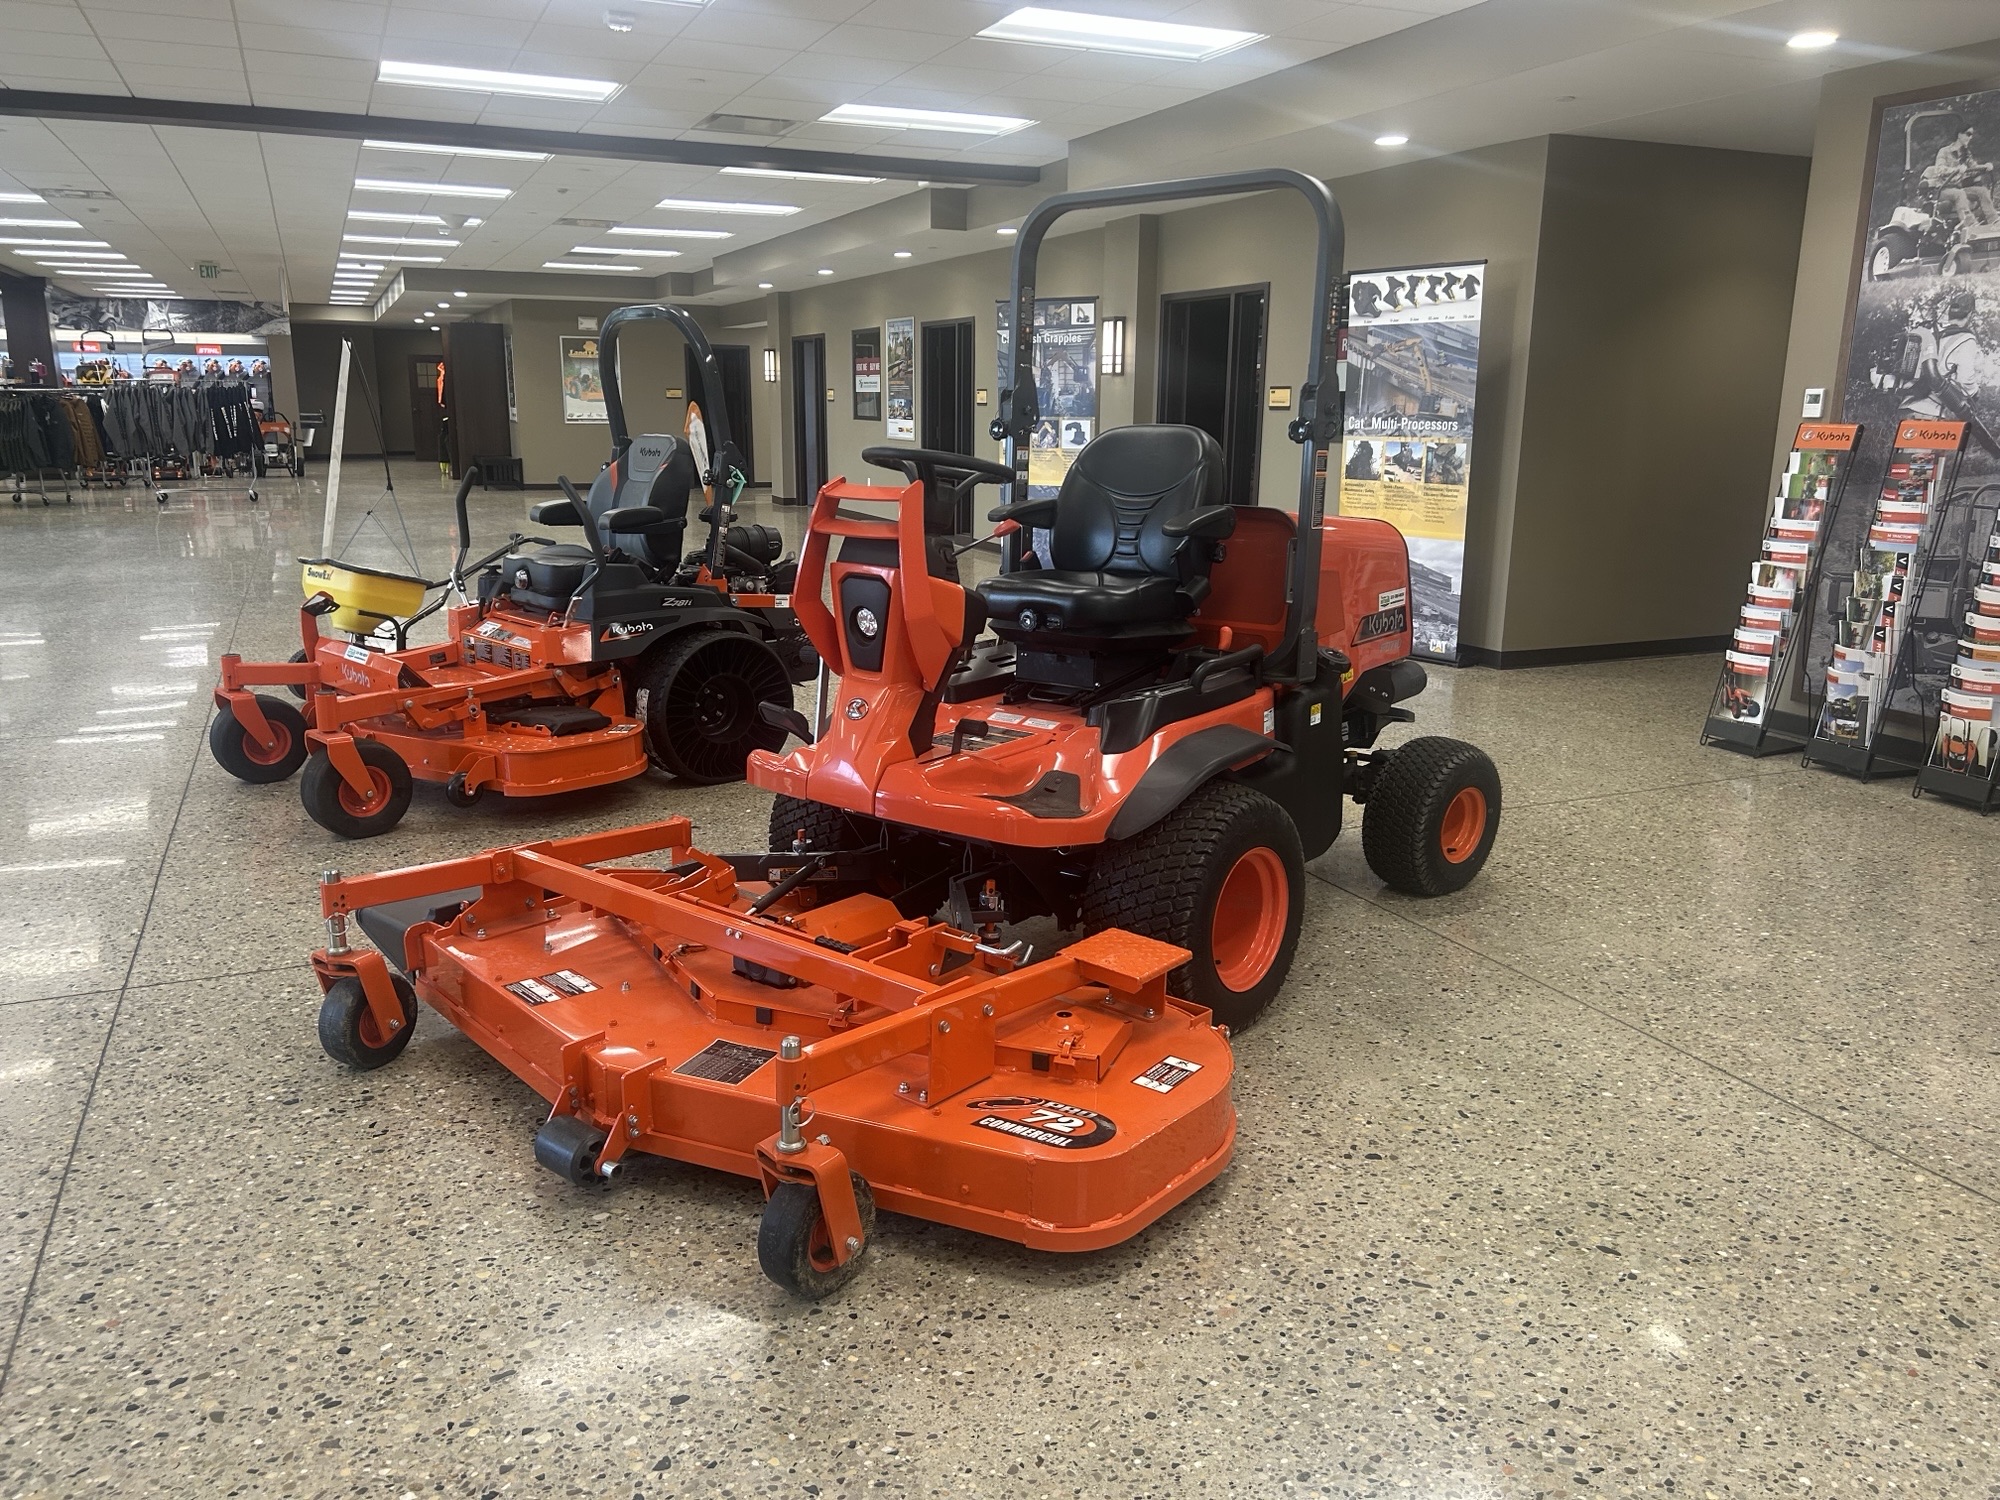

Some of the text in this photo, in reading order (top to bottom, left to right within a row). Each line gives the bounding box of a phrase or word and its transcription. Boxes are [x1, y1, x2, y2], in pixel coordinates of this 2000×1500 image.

[199, 264, 218, 279] EXIT
[1044, 333, 1082, 346] Grapples
[1372, 416, 1458, 431] Multi-Processors
[1816, 431, 1851, 442] Kubota
[1918, 429, 1957, 441] Kubota
[639, 447, 661, 457] Kubota
[611, 621, 654, 635] Kubota
[1369, 608, 1404, 634] Kubota
[1429, 639, 1448, 653] CAT
[341, 662, 371, 688] Kubota
[1020, 1108, 1085, 1134] 72
[978, 1117, 1074, 1147] COMMERCIAL
